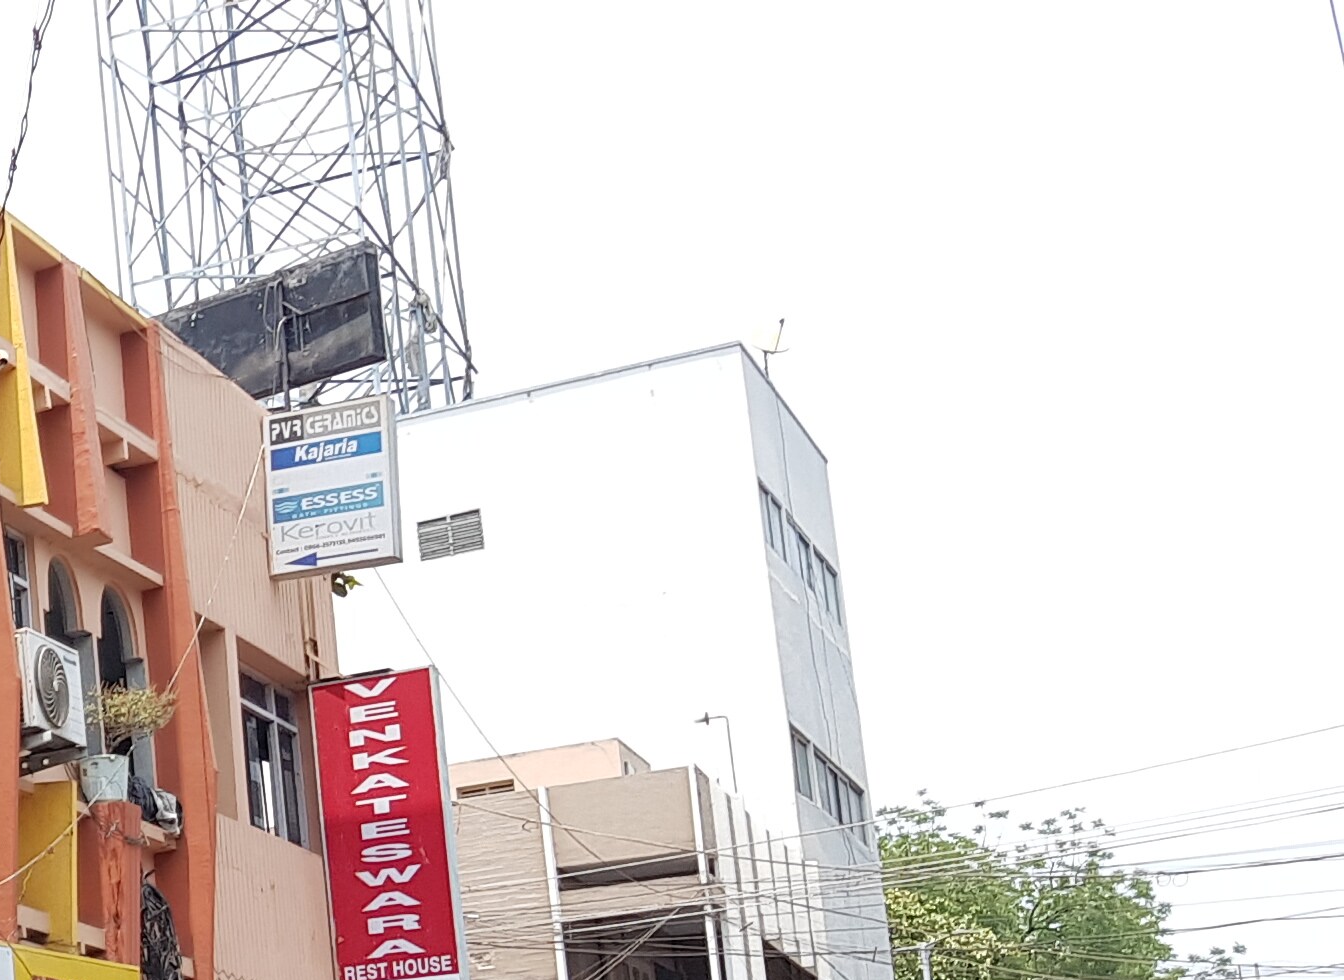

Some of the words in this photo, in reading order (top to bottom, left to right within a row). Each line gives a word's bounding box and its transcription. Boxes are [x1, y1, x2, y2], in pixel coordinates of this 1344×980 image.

[271, 419, 302, 441] PVR
[294, 438, 358, 462] Kajaria
[300, 486, 378, 510] ESSESS
[280, 511, 377, 542] Kerovit
[343, 676, 427, 959] VENKATESWARA
[393, 955, 452, 977] HOUSE
